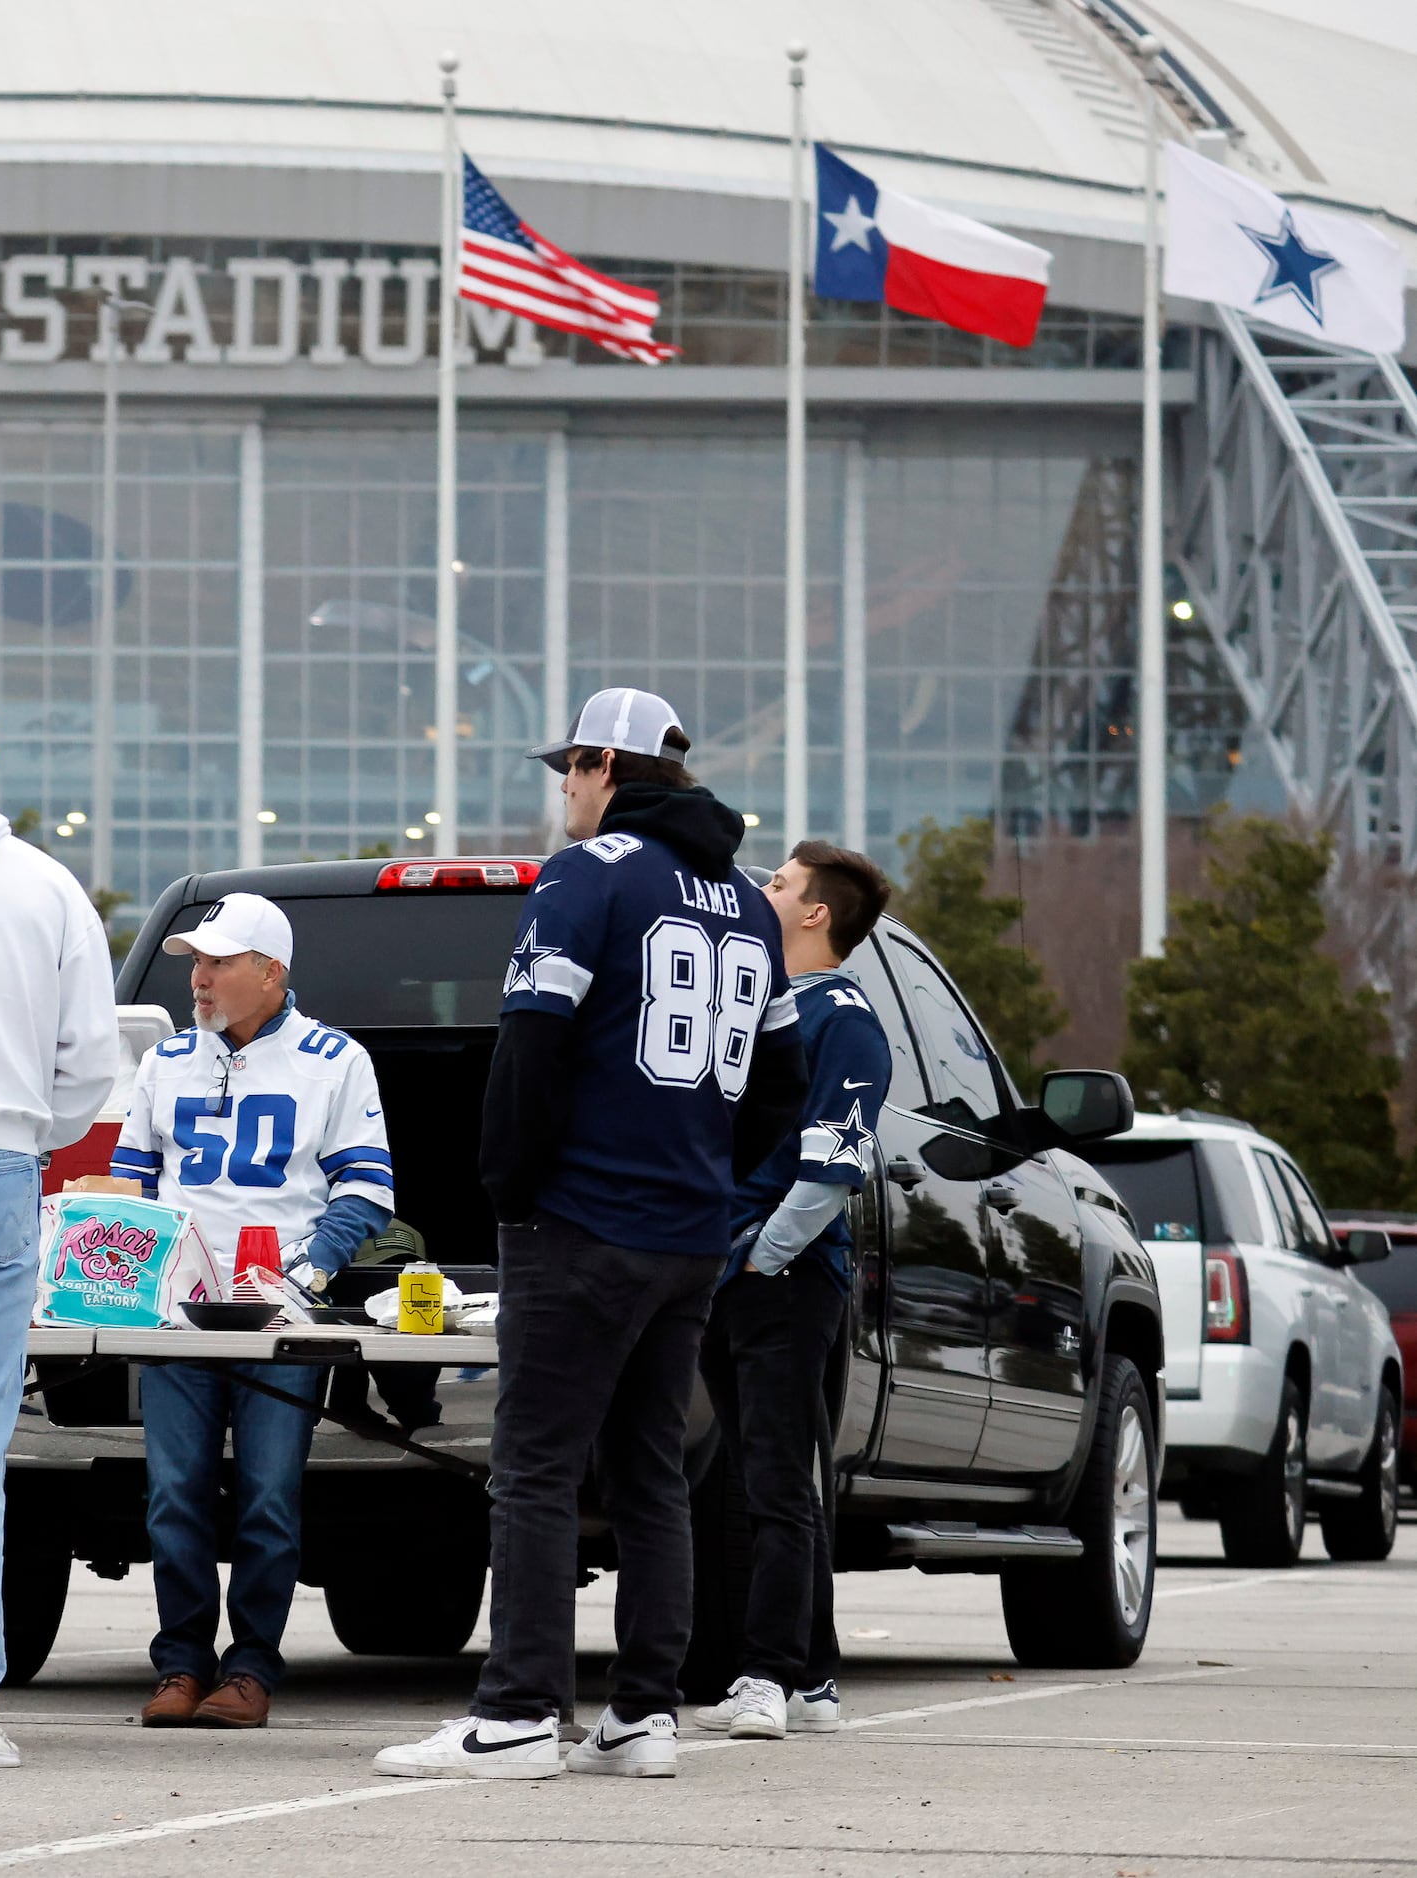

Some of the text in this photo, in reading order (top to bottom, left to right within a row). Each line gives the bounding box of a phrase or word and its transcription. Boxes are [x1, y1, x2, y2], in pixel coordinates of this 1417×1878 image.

[562, 832, 643, 864] 8
[674, 870, 741, 919] LAMB
[202, 900, 225, 923] D
[634, 914, 772, 1102] 88
[825, 987, 872, 1013] 11
[155, 1024, 199, 1059] 0
[297, 1021, 354, 1060] 5
[172, 1094, 297, 1188] 50
[54, 1216, 158, 1281] Rosa's
[58, 1280, 115, 1295] TORTILLA
[84, 1293, 140, 1310] FACTORY
[651, 1719, 672, 1728] NIKE
